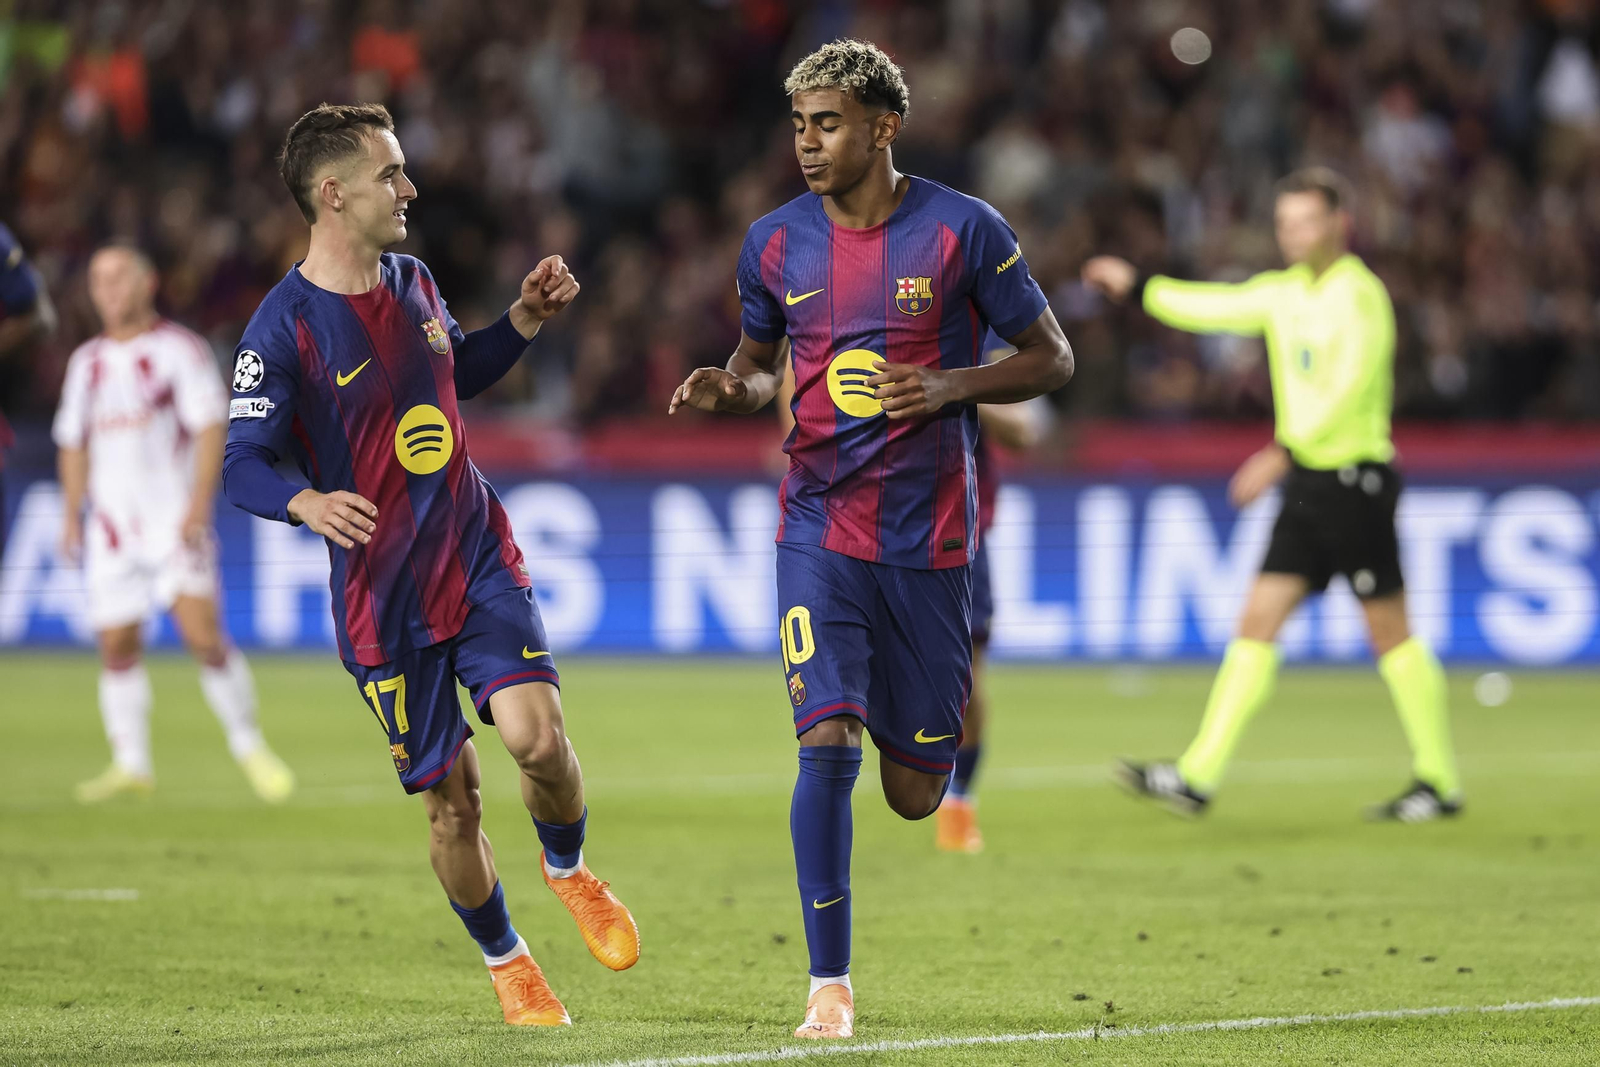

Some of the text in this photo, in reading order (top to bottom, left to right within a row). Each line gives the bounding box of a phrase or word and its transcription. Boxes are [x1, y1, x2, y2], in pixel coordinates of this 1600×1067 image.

[253, 482, 607, 653] HS
[780, 605, 816, 674] 10
[364, 673, 410, 735] 17
